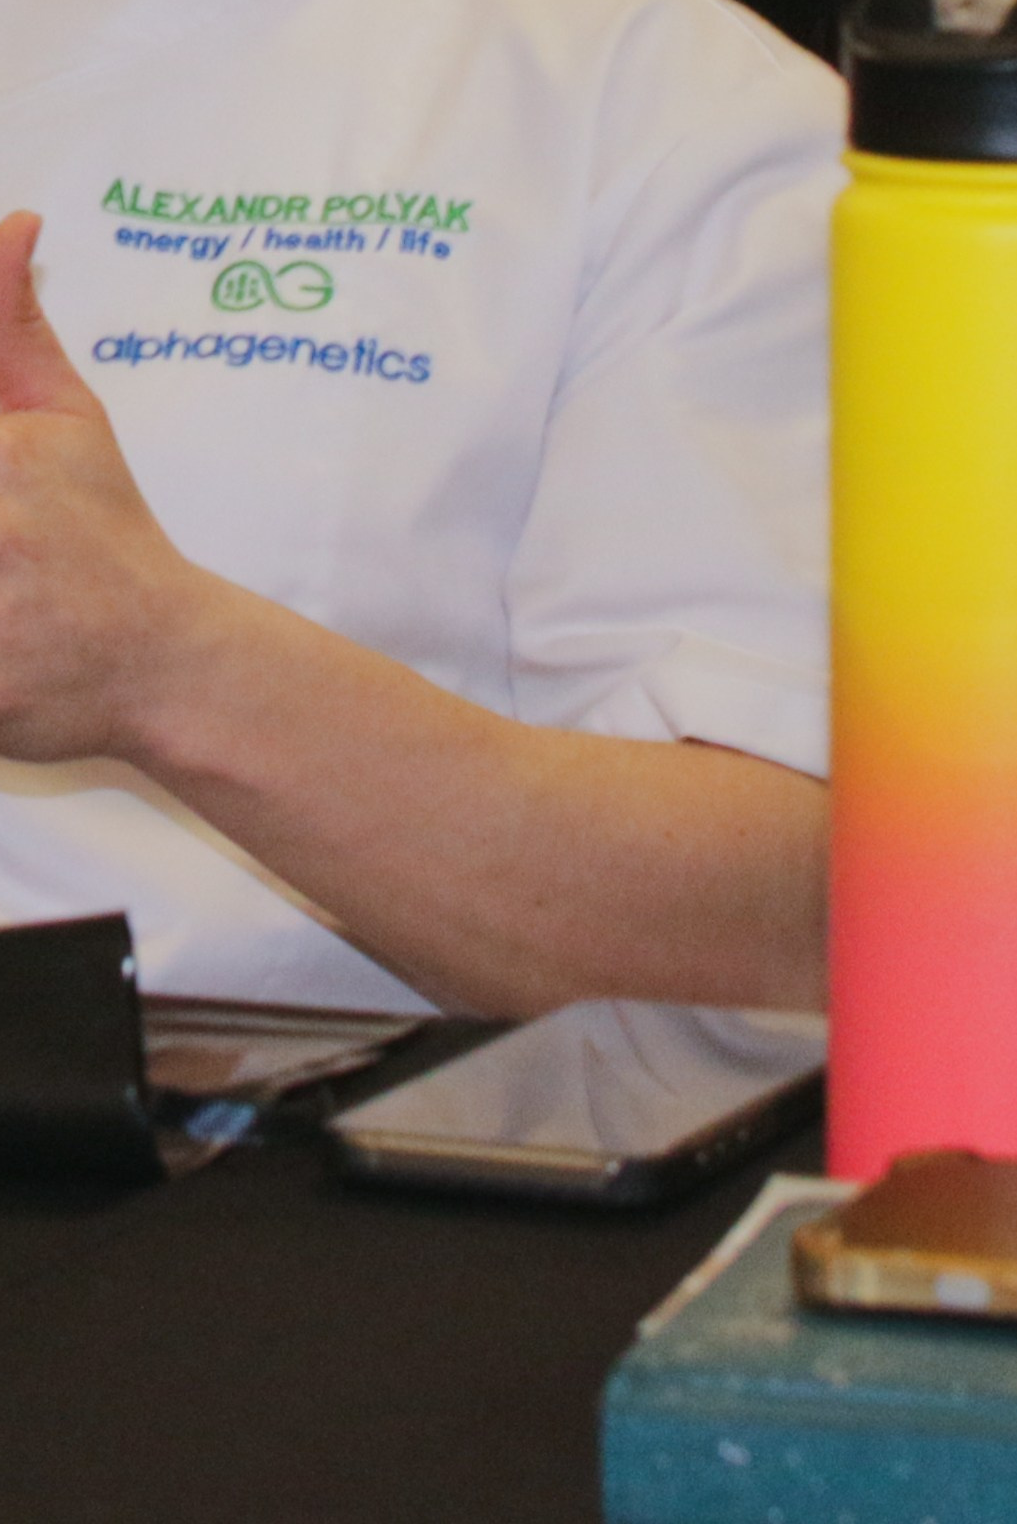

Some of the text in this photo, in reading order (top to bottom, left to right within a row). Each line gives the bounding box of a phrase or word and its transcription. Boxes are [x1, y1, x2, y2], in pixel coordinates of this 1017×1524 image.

[101, 178, 474, 232] ALEXANDR POLYAK
[115, 226, 230, 261] energy
[264, 228, 367, 252] health
[400, 228, 452, 260] life
[92, 329, 433, 384] alphagenetics
